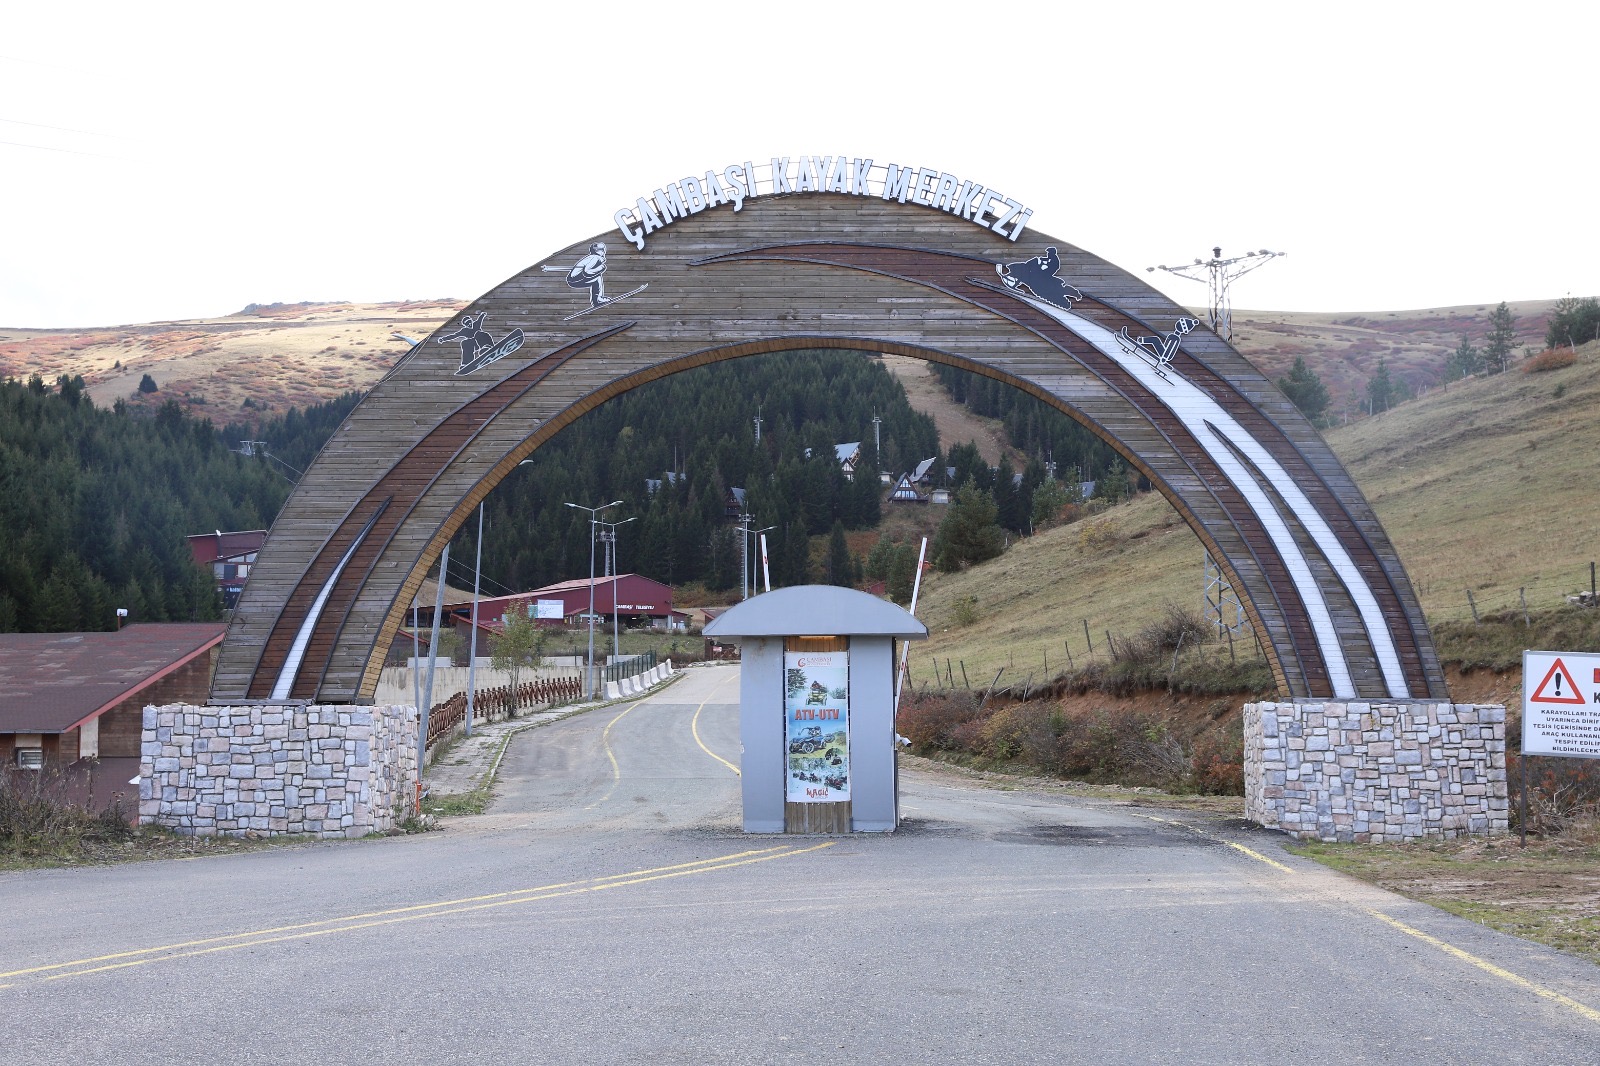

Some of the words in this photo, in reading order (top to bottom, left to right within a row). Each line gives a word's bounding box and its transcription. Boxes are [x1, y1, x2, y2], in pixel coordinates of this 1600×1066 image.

[614, 161, 757, 251] ÇAMBAŞI
[770, 155, 873, 197] KAYAK
[881, 163, 1034, 242] MERKEZİ
[794, 709, 840, 721] ATV-UTV
